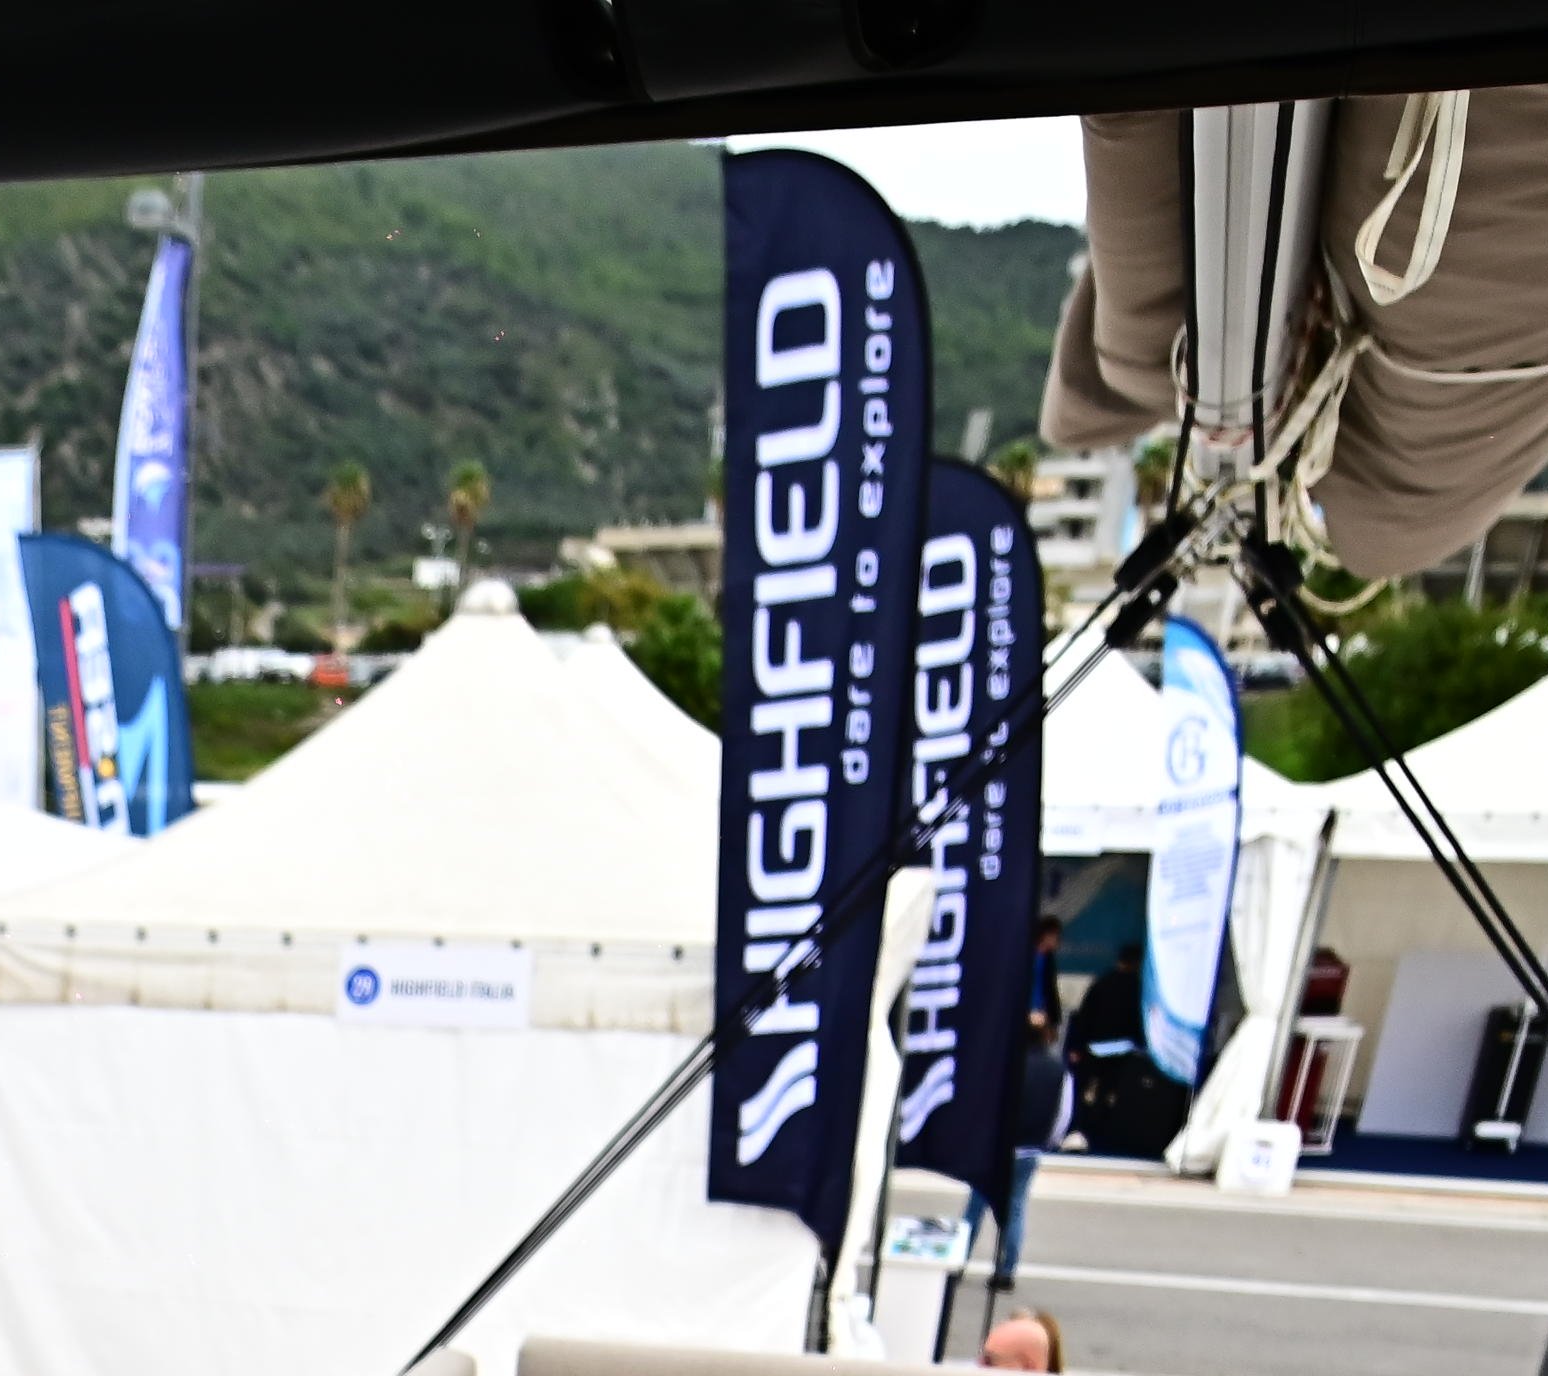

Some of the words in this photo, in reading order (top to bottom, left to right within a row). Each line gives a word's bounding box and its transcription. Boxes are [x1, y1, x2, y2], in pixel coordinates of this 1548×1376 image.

[858, 258, 896, 519] explore
[742, 266, 843, 1036] HIGHFIELD
[850, 547, 879, 614] to
[986, 524, 1015, 700] explore
[841, 638, 876, 786] dare
[903, 532, 977, 1052] HIGHFIELD
[979, 779, 1006, 881] dare
